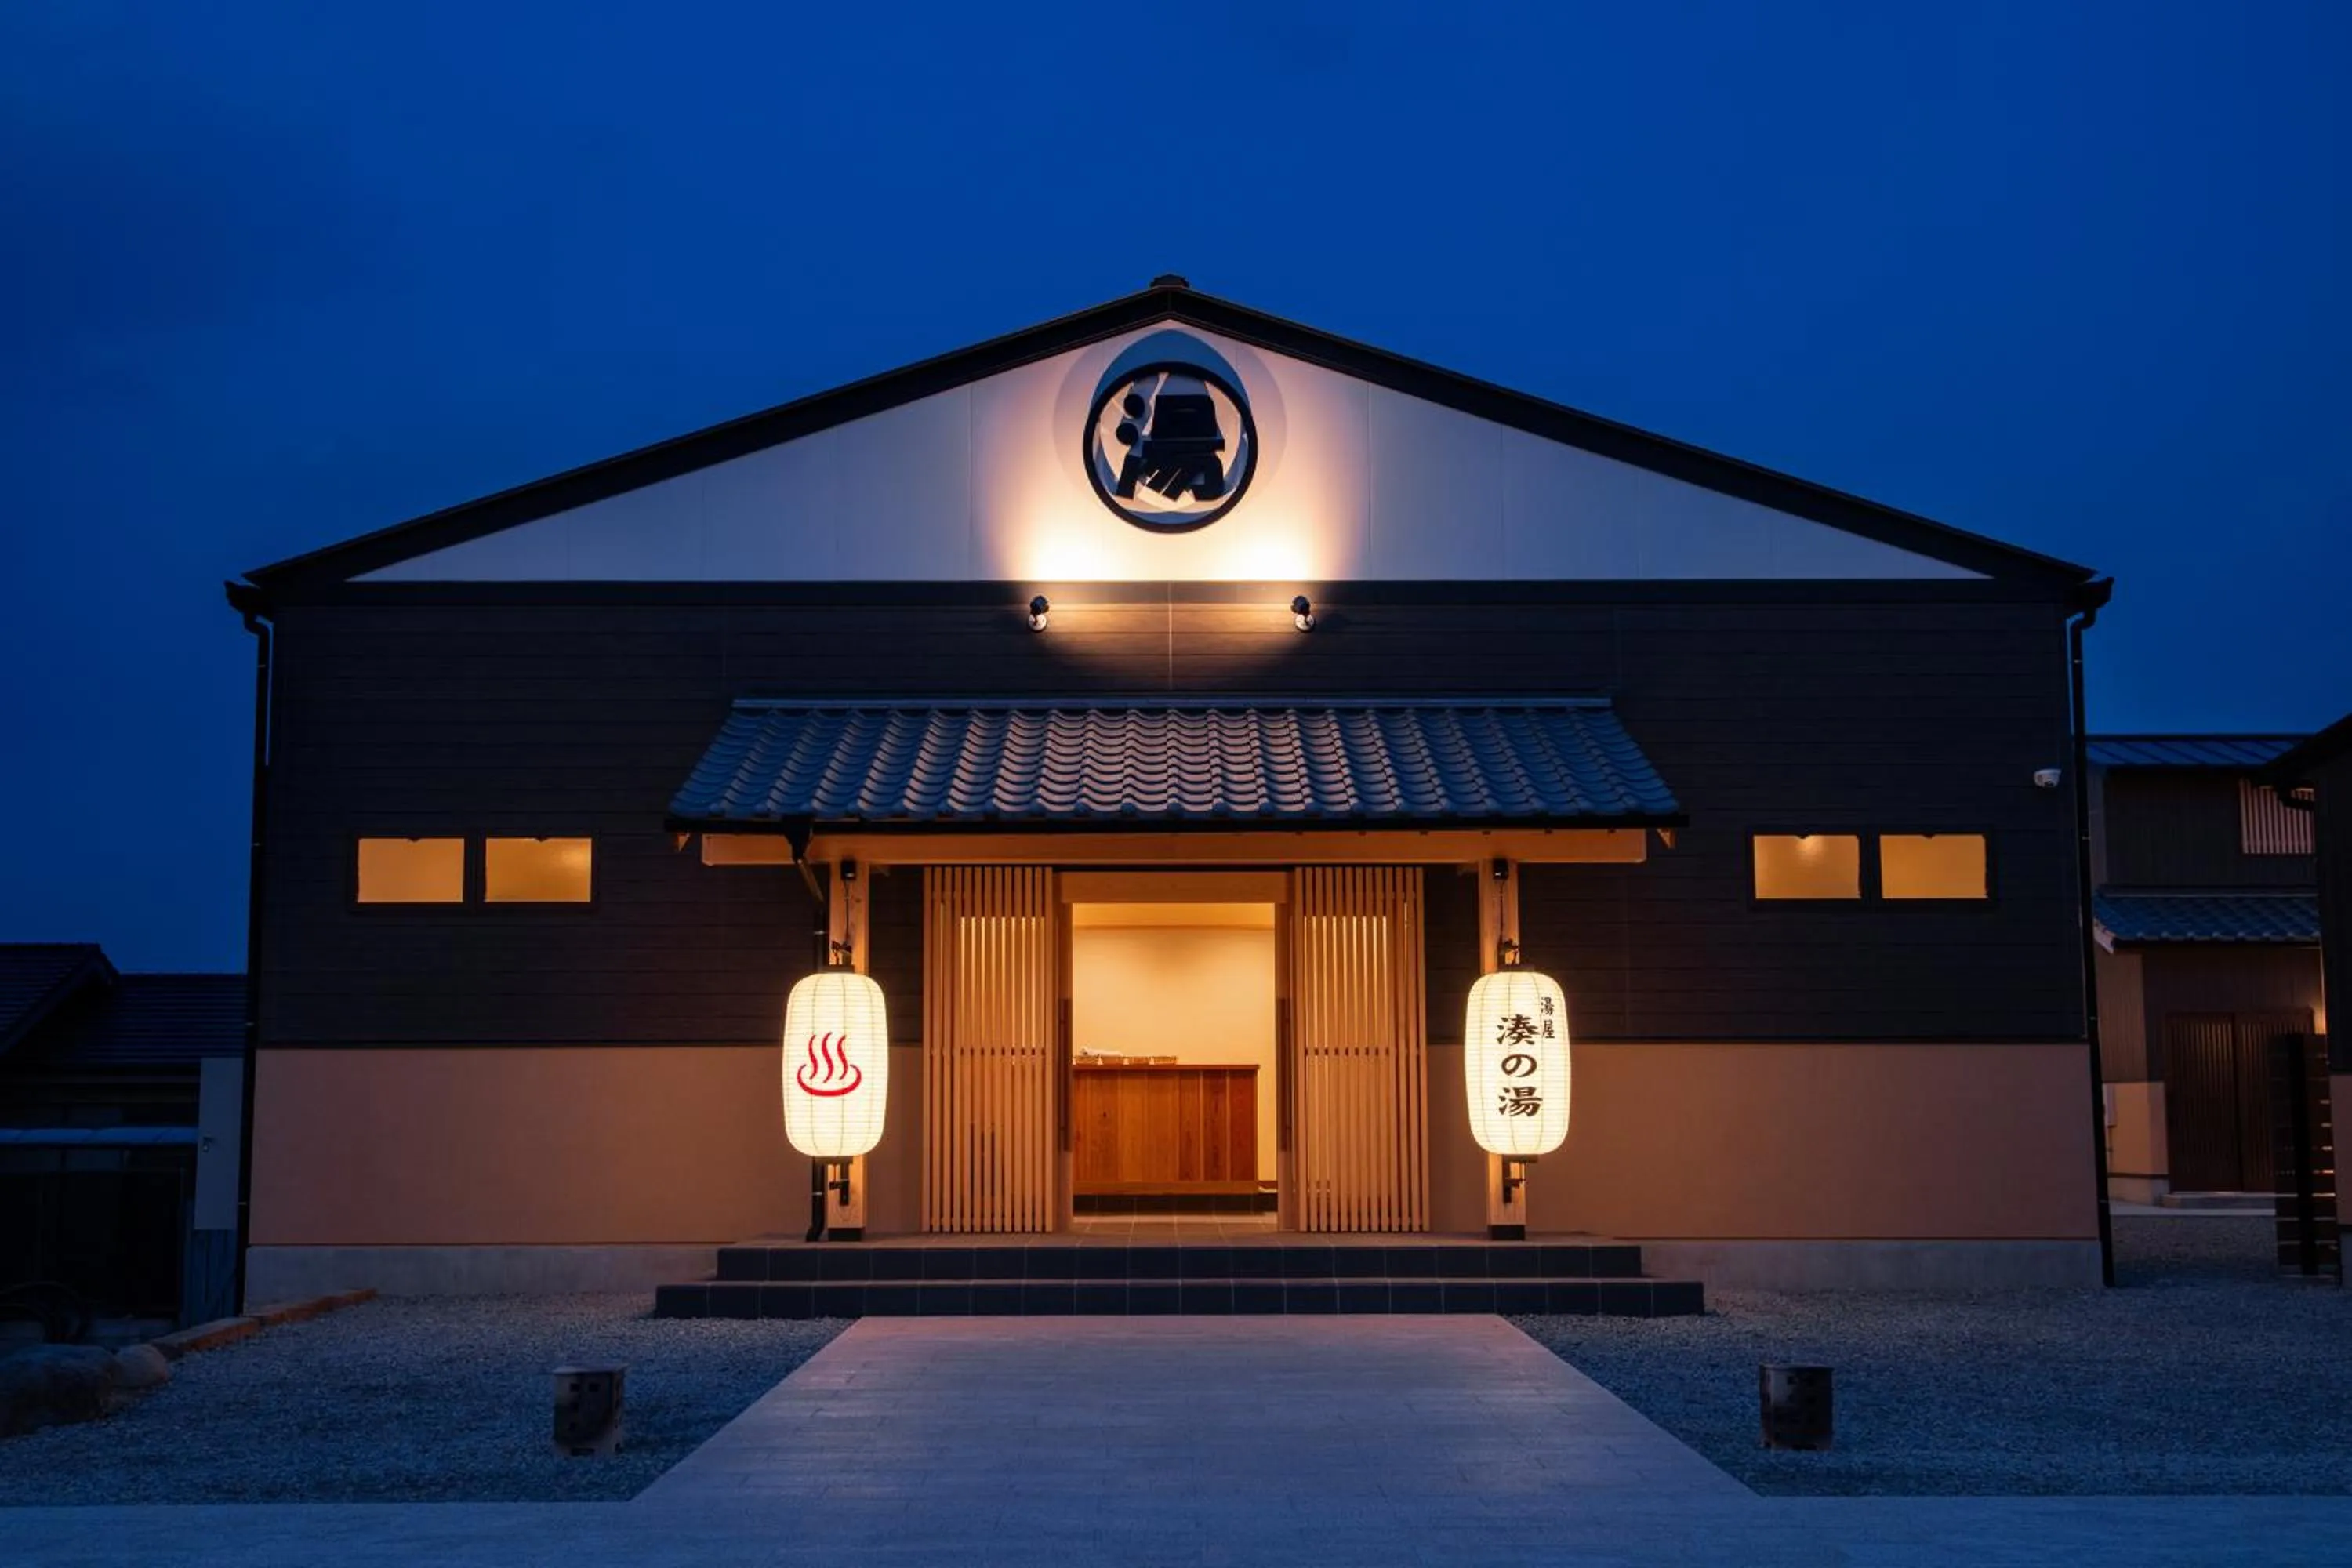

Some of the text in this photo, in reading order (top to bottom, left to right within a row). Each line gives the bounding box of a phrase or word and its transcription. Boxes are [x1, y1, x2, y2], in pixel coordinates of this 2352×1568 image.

[1541, 996, 1555, 1039] 湯屋
[1497, 1014, 1544, 1117] 湊の湯
